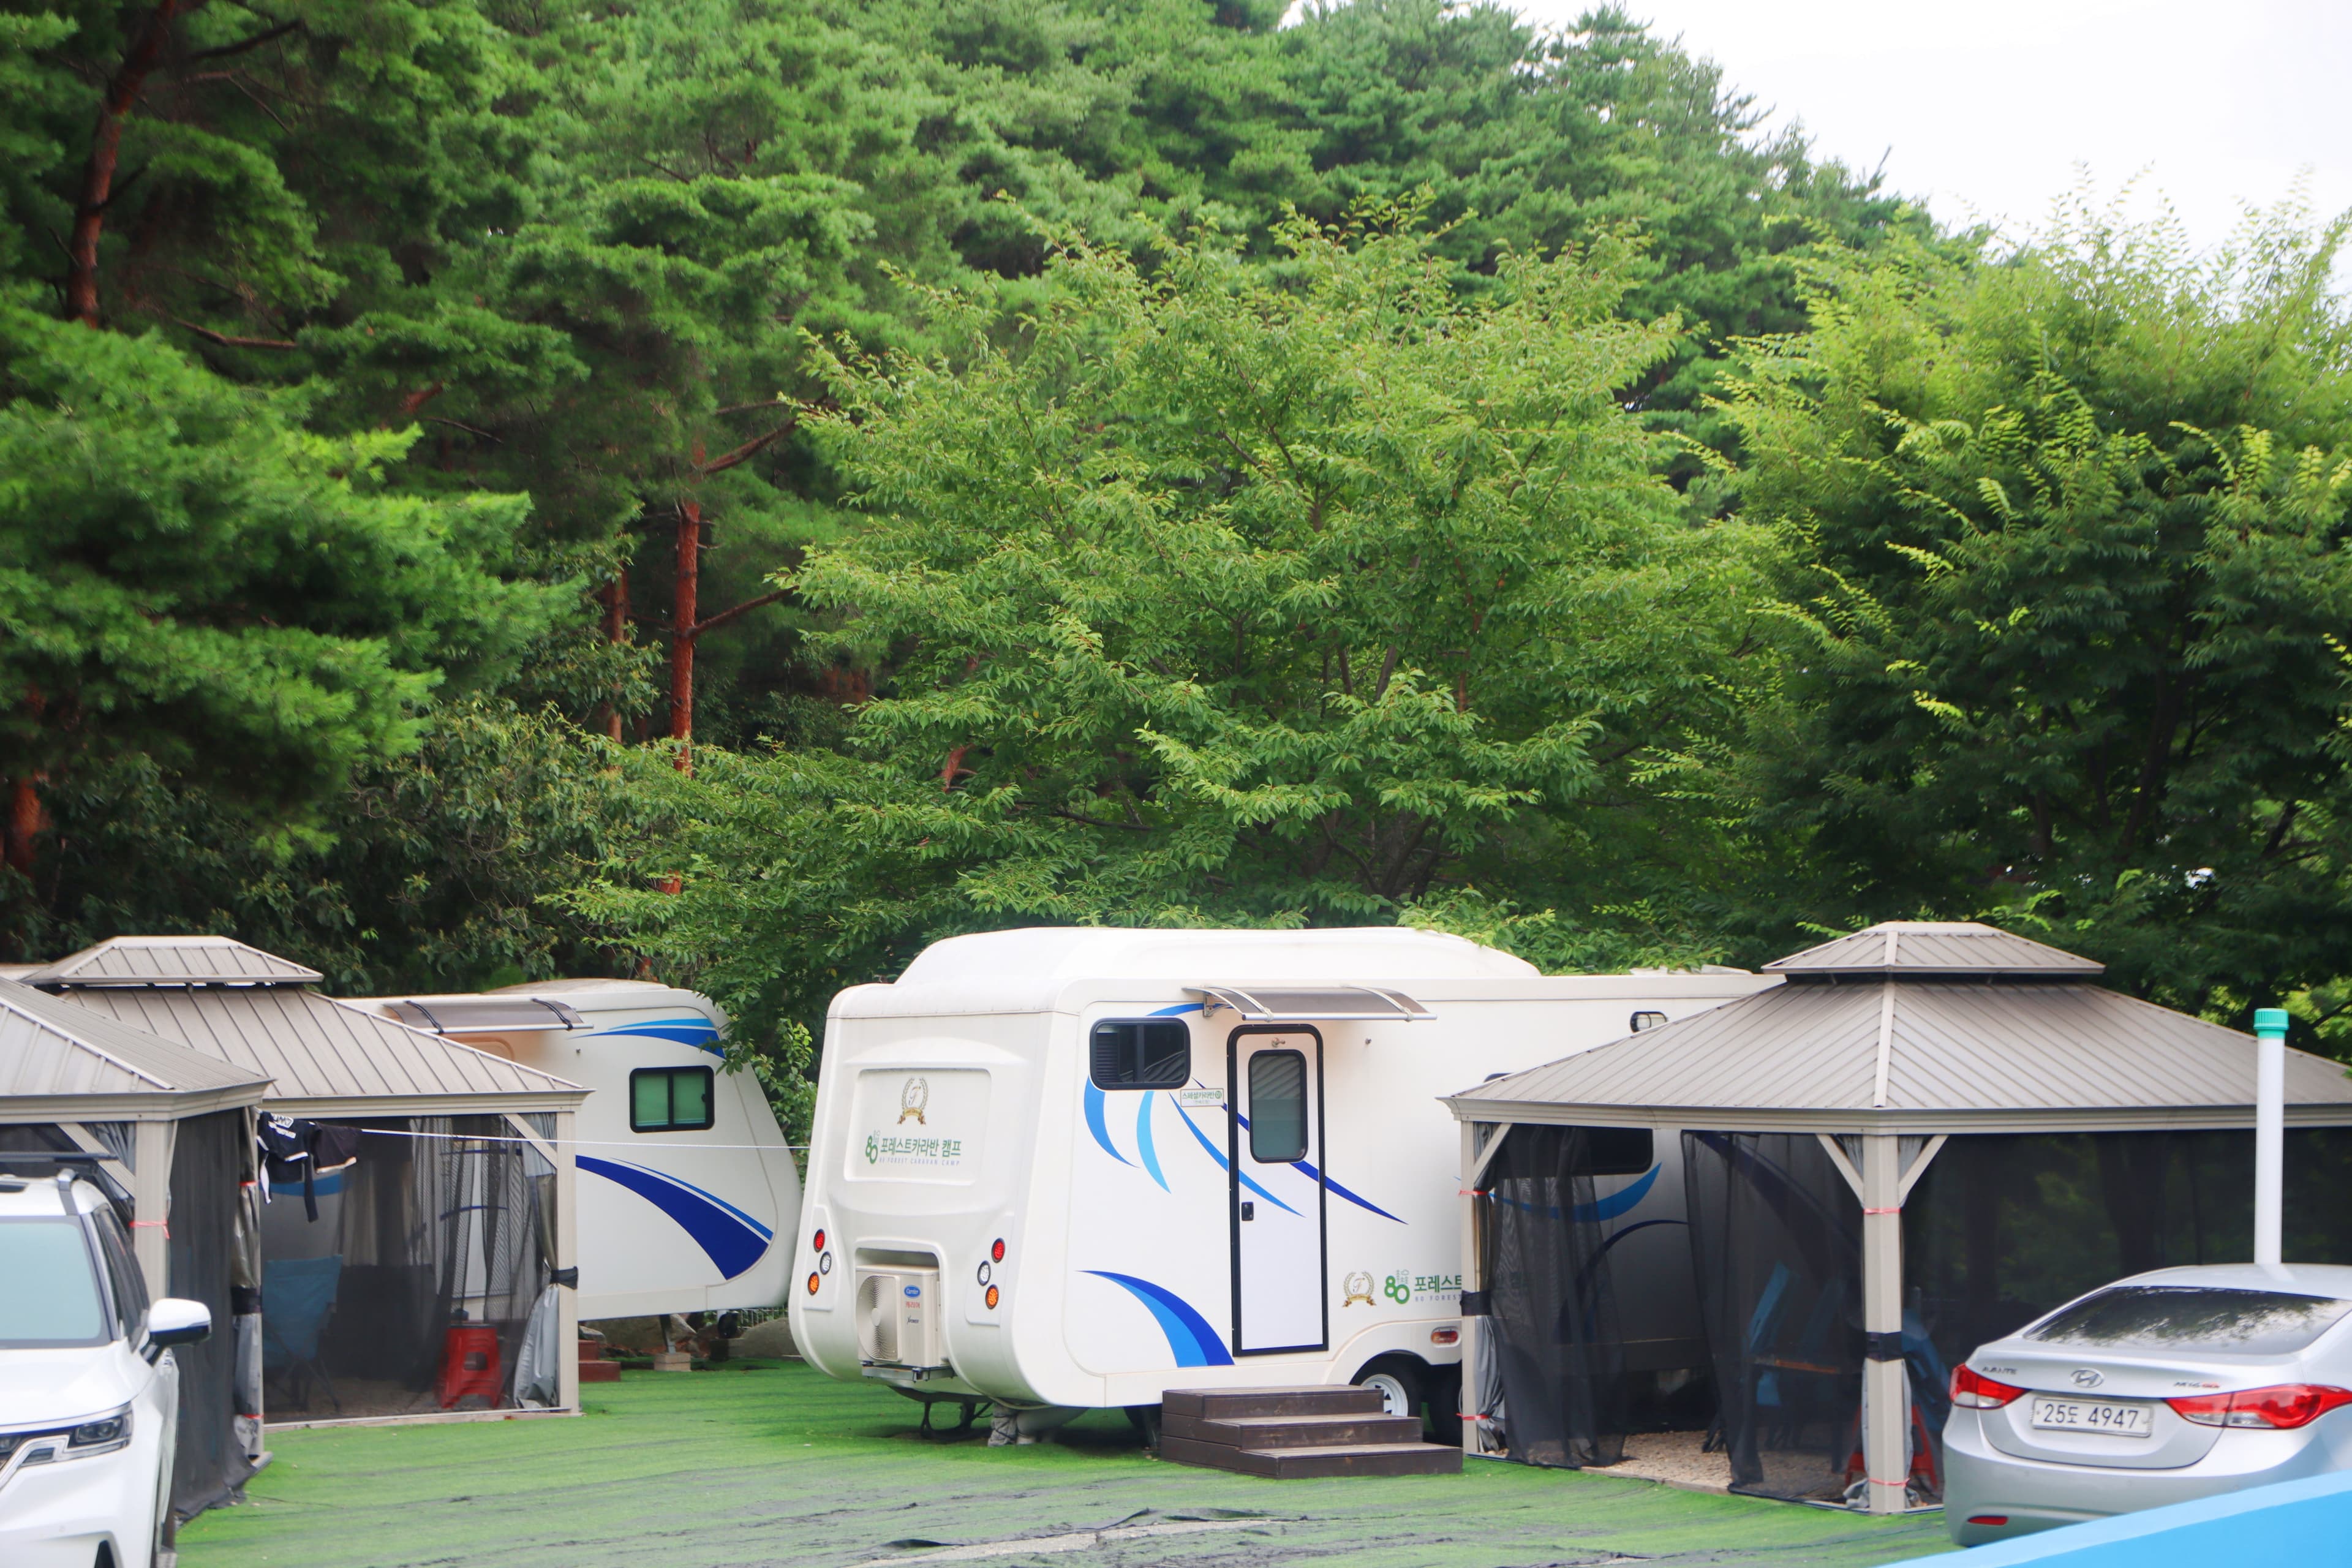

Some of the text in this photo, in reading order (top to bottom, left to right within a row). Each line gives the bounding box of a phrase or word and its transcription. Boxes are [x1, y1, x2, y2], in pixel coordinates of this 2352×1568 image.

[880, 1137, 961, 1158] 포레스트카라반 캠프
[2043, 1403, 2138, 1429] 25도 4947
